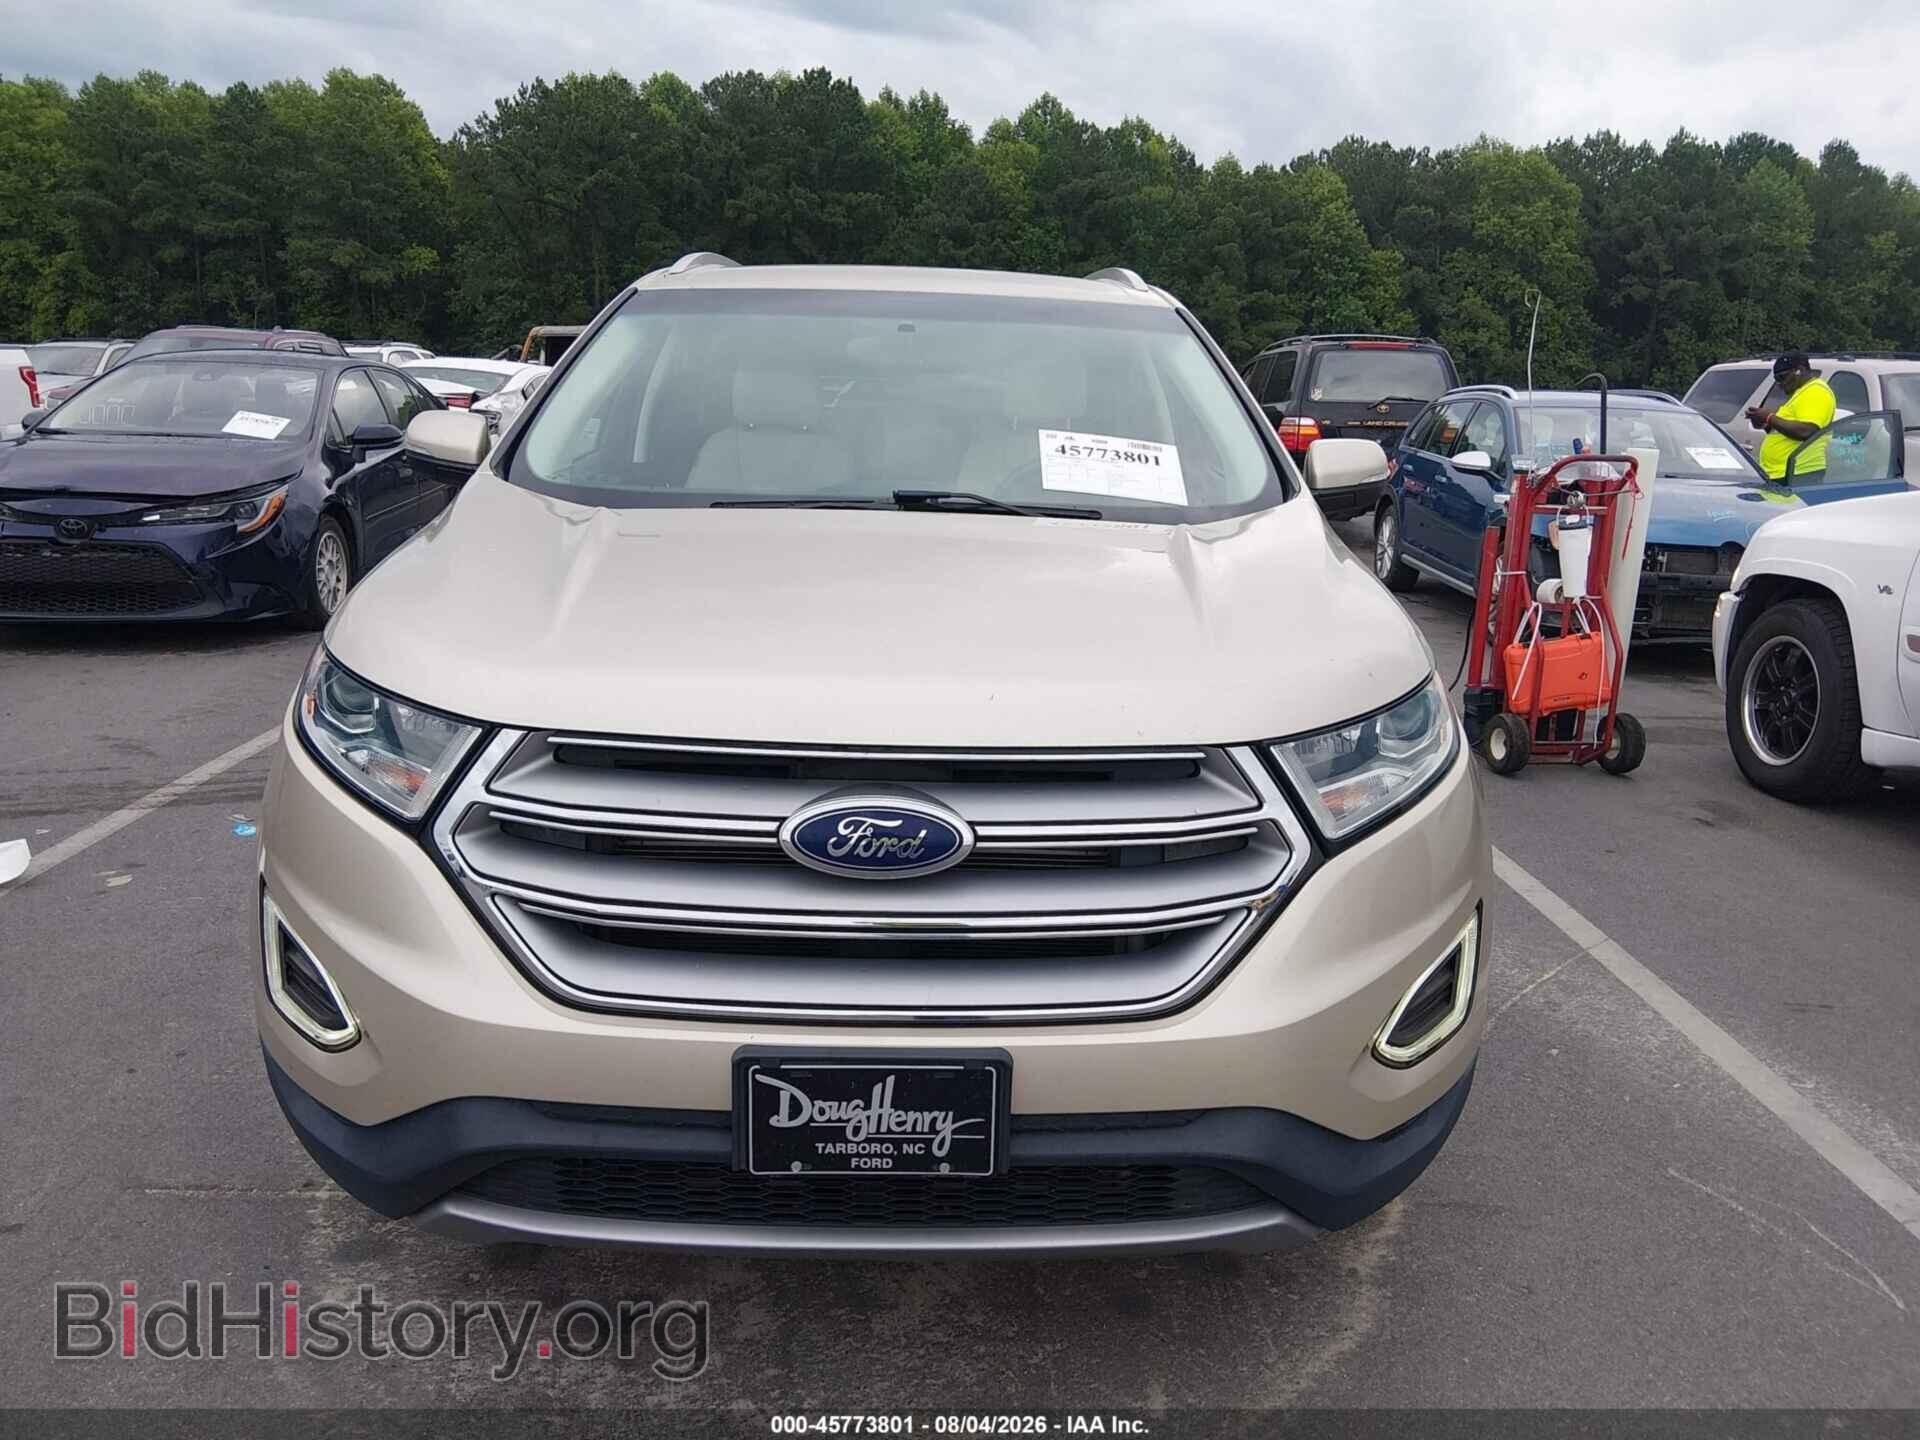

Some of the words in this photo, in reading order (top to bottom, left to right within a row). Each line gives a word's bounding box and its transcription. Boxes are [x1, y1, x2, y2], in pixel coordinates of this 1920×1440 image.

[1055, 444, 1161, 467] 45773801
[827, 816, 927, 859] Ford
[815, 1143, 898, 1156] TARBORO,
[902, 1143, 926, 1155] NC
[850, 1158, 893, 1169] FORD
